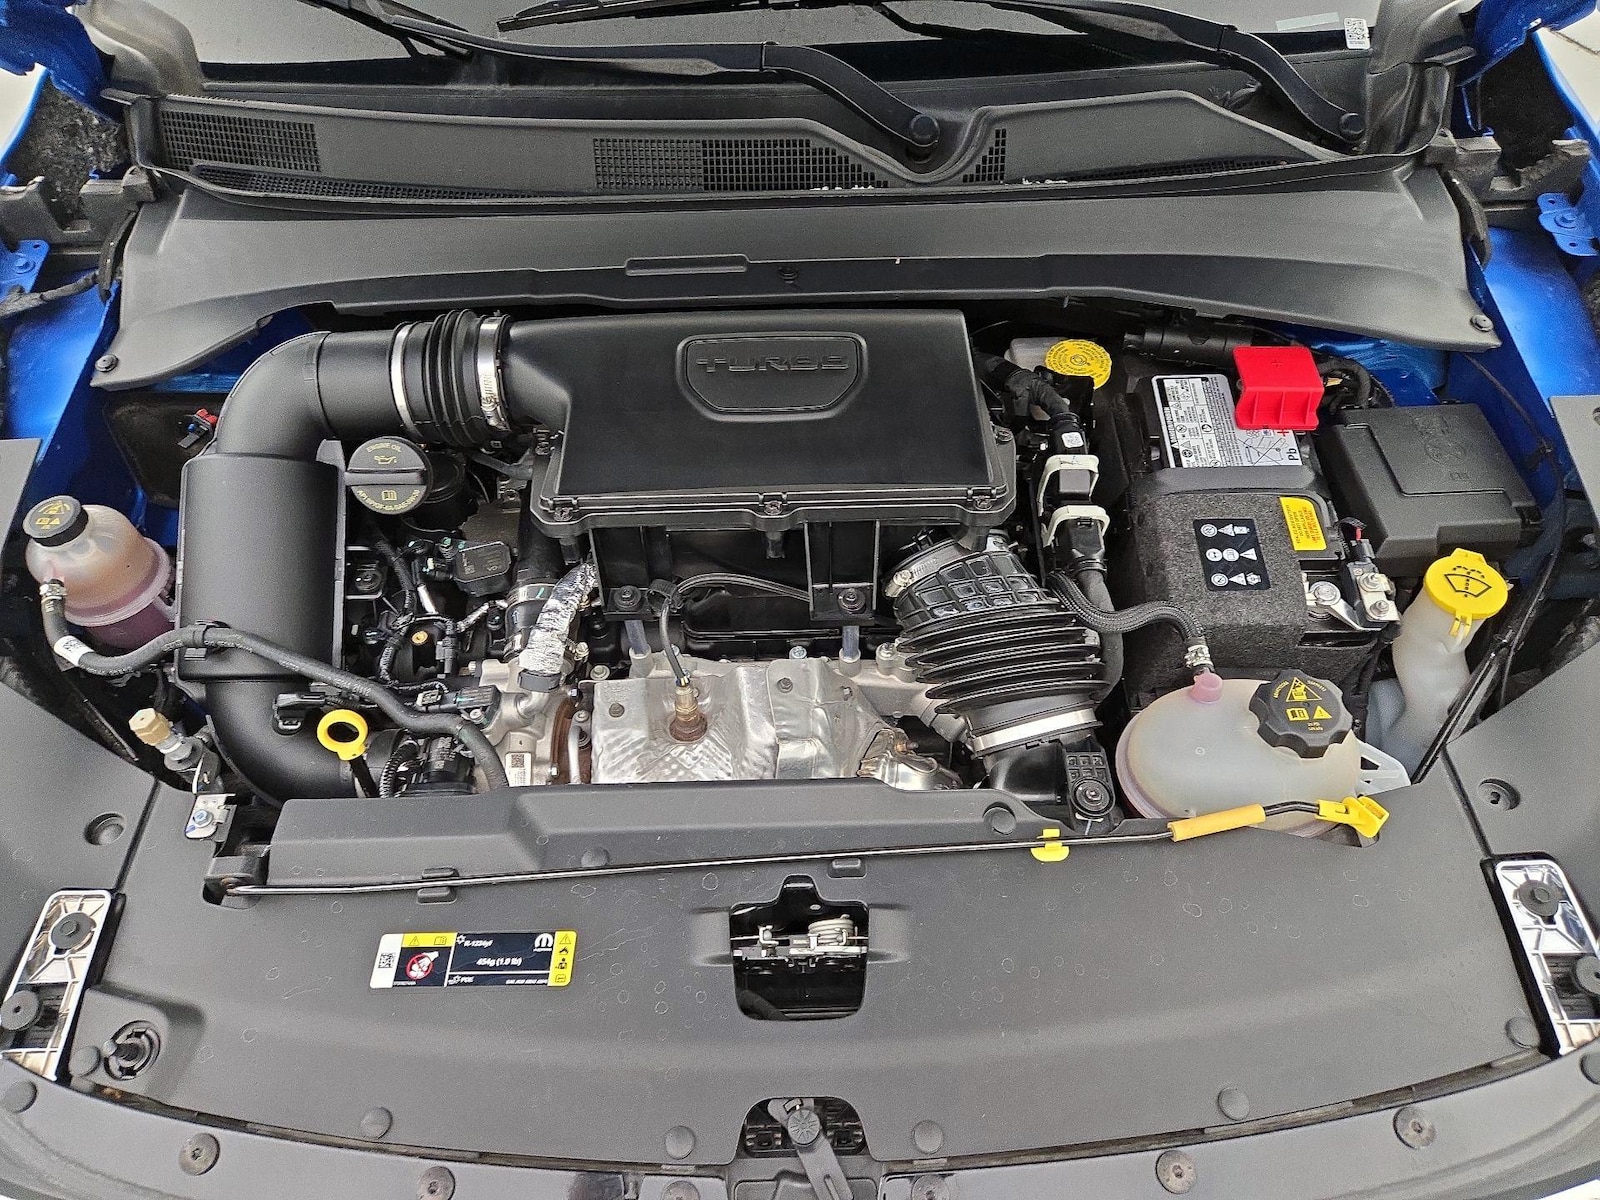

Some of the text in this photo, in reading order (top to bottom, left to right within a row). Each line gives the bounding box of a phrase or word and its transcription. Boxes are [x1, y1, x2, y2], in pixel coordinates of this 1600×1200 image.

[696, 355, 849, 373] TURBO
[366, 442, 402, 453] ENGINE OIL
[1286, 448, 1299, 461] Pb
[464, 940, 493, 948] R-1234yf
[477, 958, 495, 967] 454g
